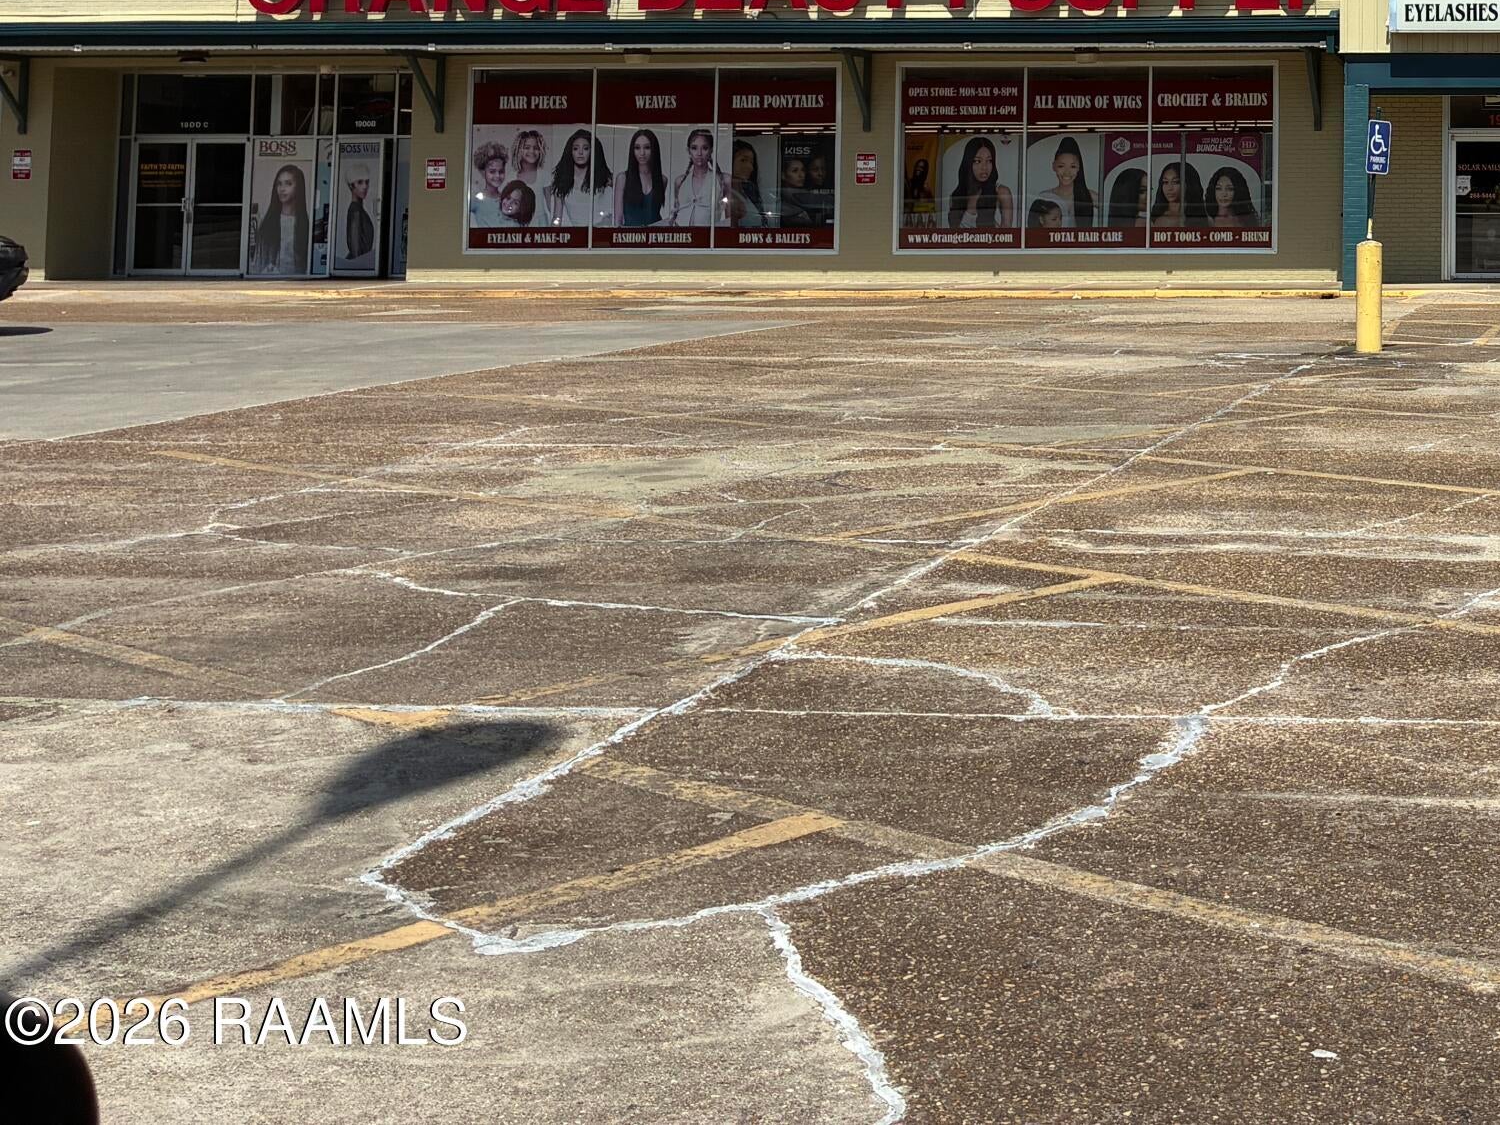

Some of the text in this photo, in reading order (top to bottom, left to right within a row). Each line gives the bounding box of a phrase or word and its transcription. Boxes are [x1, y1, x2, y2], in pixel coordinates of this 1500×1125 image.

[1404, 2, 1499, 22] EYELASHES
[908, 86, 1018, 97] OPEN STORE: MON-SAT 9-8PM
[499, 95, 568, 109] HAIR PIECES
[634, 94, 677, 109] WEAVES
[731, 94, 824, 108] HAIR PONYTAILS
[1033, 94, 1143, 109] ALL KINDS OF WIGS
[1157, 92, 1268, 107] CROCHET & BRAIDS
[908, 105, 1017, 116] OPEN STORE: SUNDAY 11-6PM
[259, 140, 297, 153] BOSS
[784, 146, 811, 155] KISS
[1457, 163, 1481, 171] SOLAR
[487, 233, 571, 244] EYELASH & MAKE-UP
[612, 232, 692, 243] FASHION JEWELRIES
[738, 233, 811, 244] BOWS & BALLETS
[907, 231, 1013, 244] www.OrangeBeauty.com
[1049, 231, 1123, 243] TOTAL HAIR CARE
[1153, 231, 1173, 243] HOT
[1173, 231, 1202, 243] TOOLS
[1209, 231, 1234, 242] COMB
[1241, 231, 1270, 242] BRUSH
